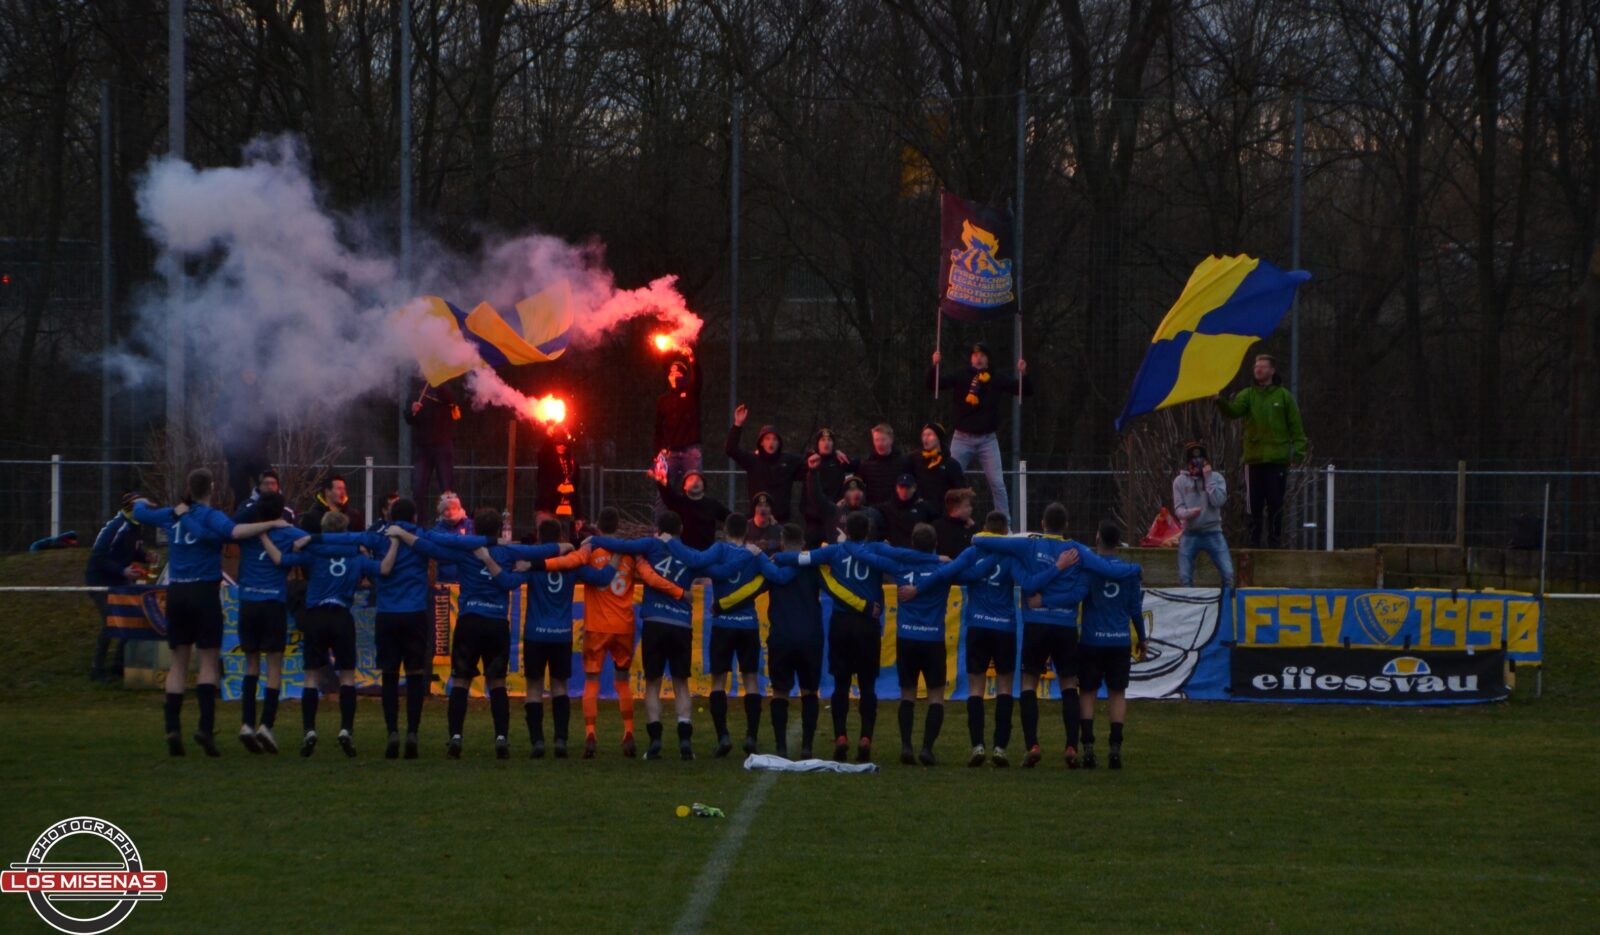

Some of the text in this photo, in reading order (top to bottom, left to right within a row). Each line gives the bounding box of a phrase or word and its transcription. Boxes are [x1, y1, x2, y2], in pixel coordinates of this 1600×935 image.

[329, 557, 347, 577] 8
[654, 555, 688, 582] 47
[842, 555, 870, 580] 10
[547, 571, 563, 593] 9
[1244, 595, 1348, 645] FSV
[1414, 596, 1541, 653] 1990
[1252, 666, 1479, 692] effessvau
